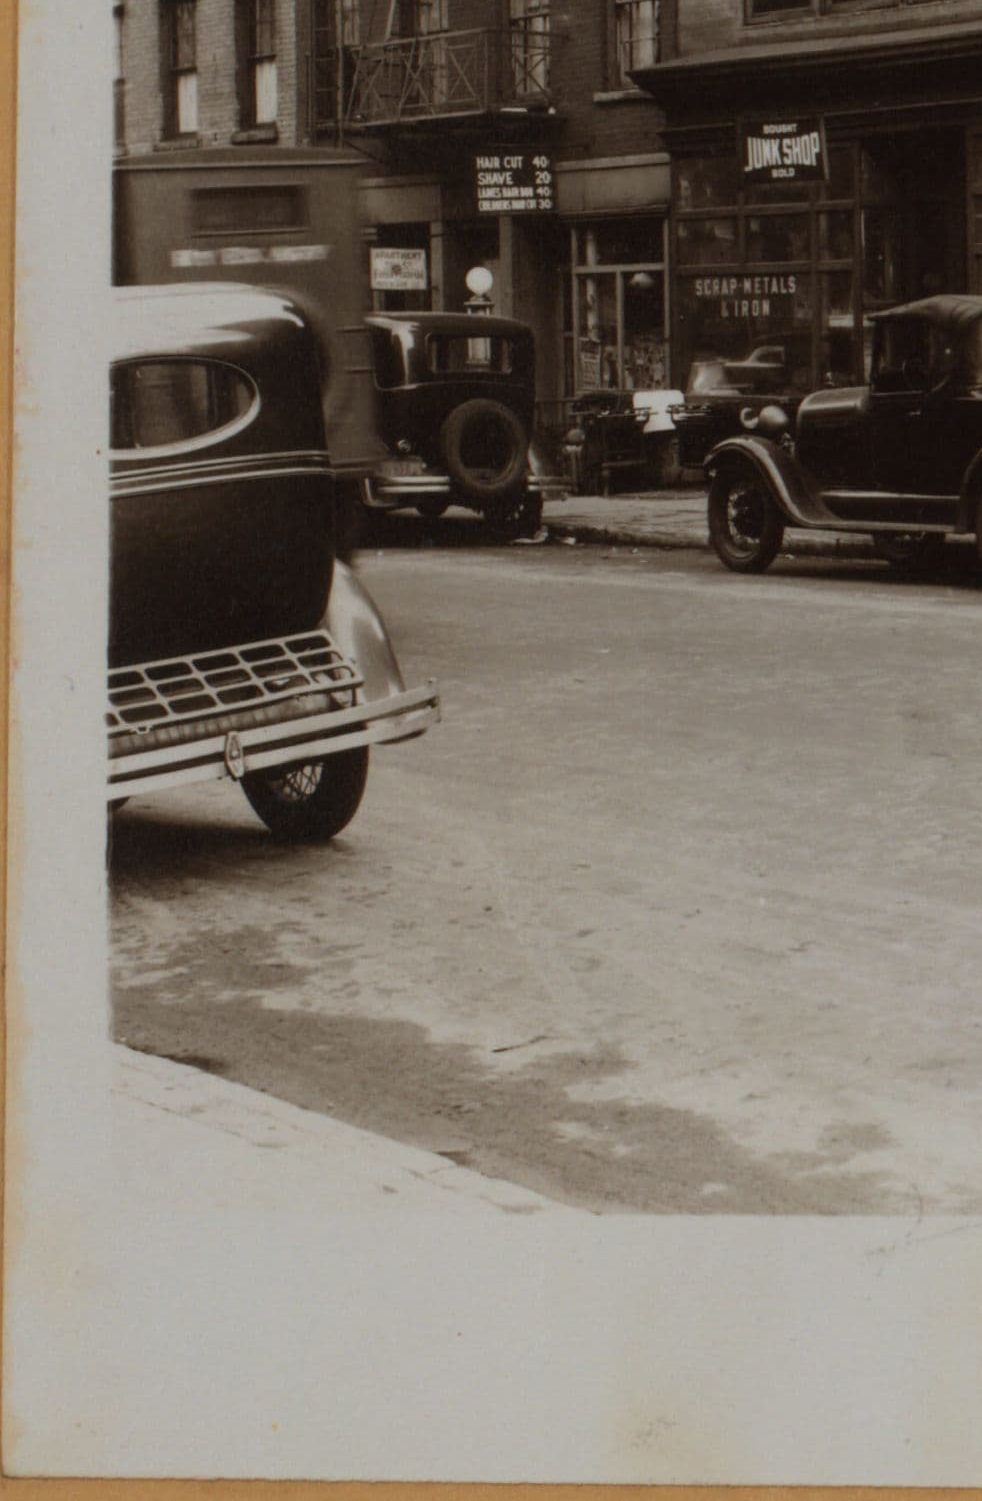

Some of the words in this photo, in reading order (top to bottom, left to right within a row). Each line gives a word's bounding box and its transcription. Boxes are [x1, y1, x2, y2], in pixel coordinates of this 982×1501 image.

[763, 123, 798, 135] BOUGHT
[744, 136, 782, 172] JUNK
[782, 131, 820, 166] SHOP
[476, 155, 500, 170] HAIR
[503, 155, 523, 169] CUT
[477, 171, 513, 186] SHAVE
[771, 167, 795, 179] SOLD
[735, 299, 770, 317] IRON
